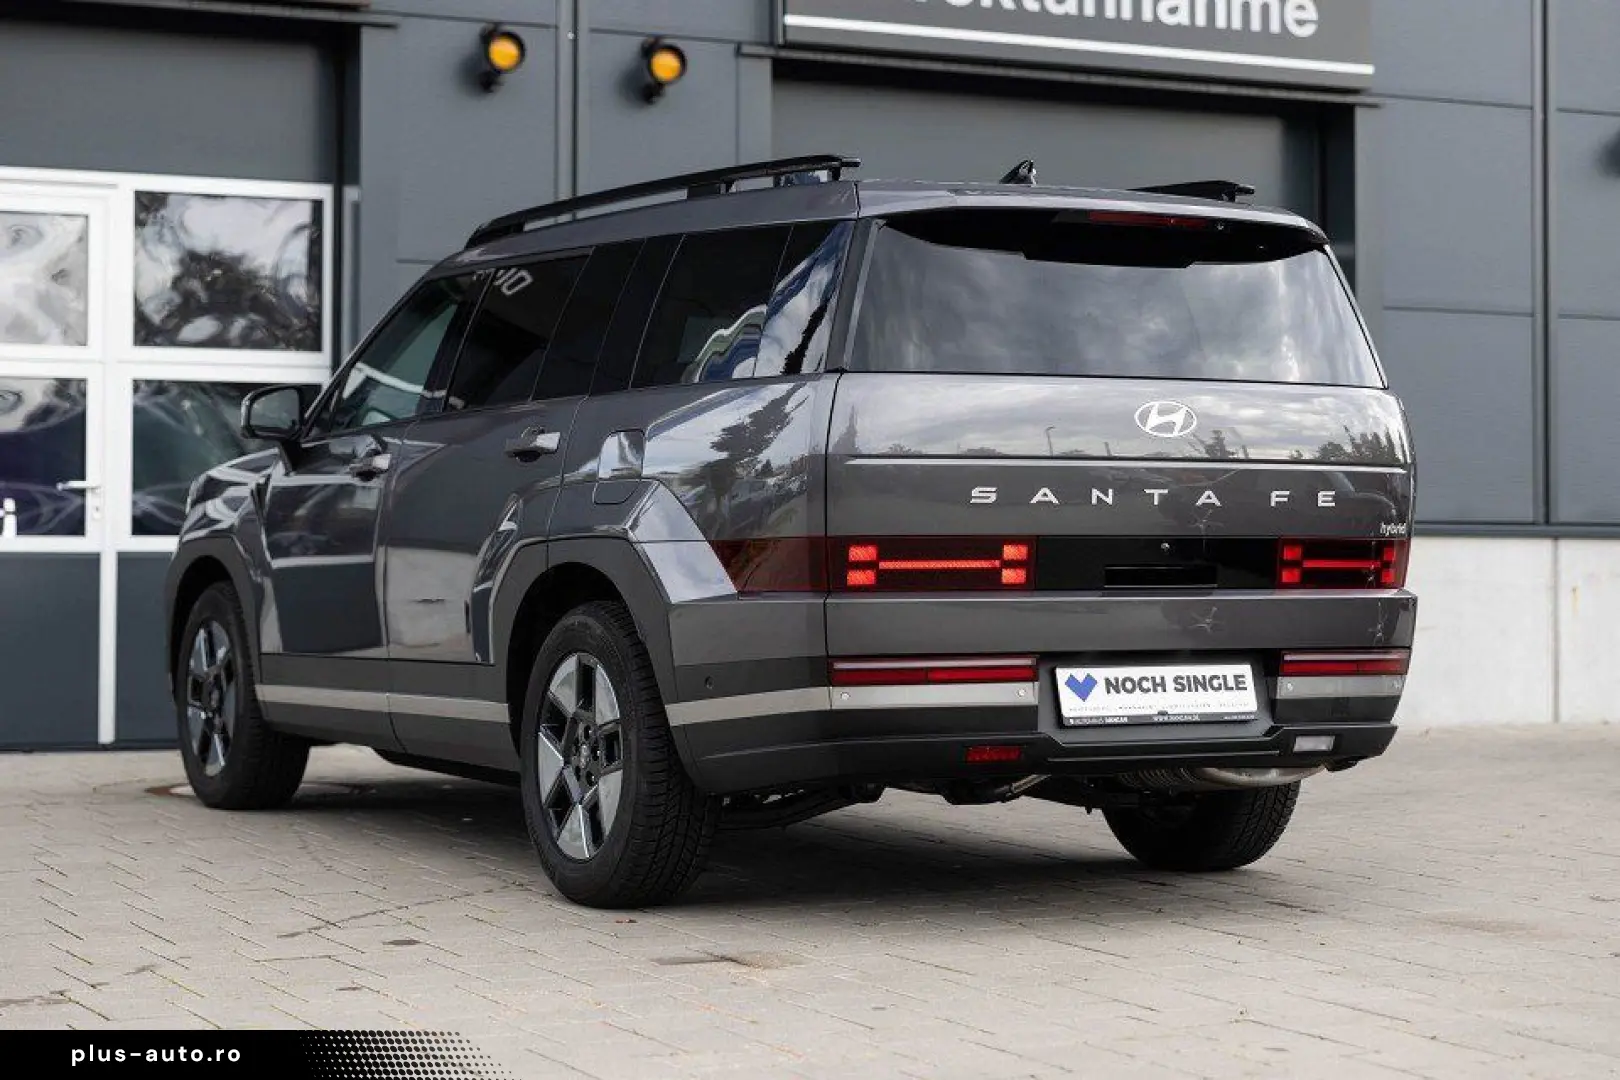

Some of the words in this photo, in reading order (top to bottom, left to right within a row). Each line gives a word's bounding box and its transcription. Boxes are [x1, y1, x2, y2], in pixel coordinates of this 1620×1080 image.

[914, 0, 1319, 37] nnahme
[969, 487, 1221, 507] SANTA
[1270, 490, 1337, 507] FE
[1104, 676, 1167, 694] NOCH
[1173, 674, 1248, 692] SINGLE
